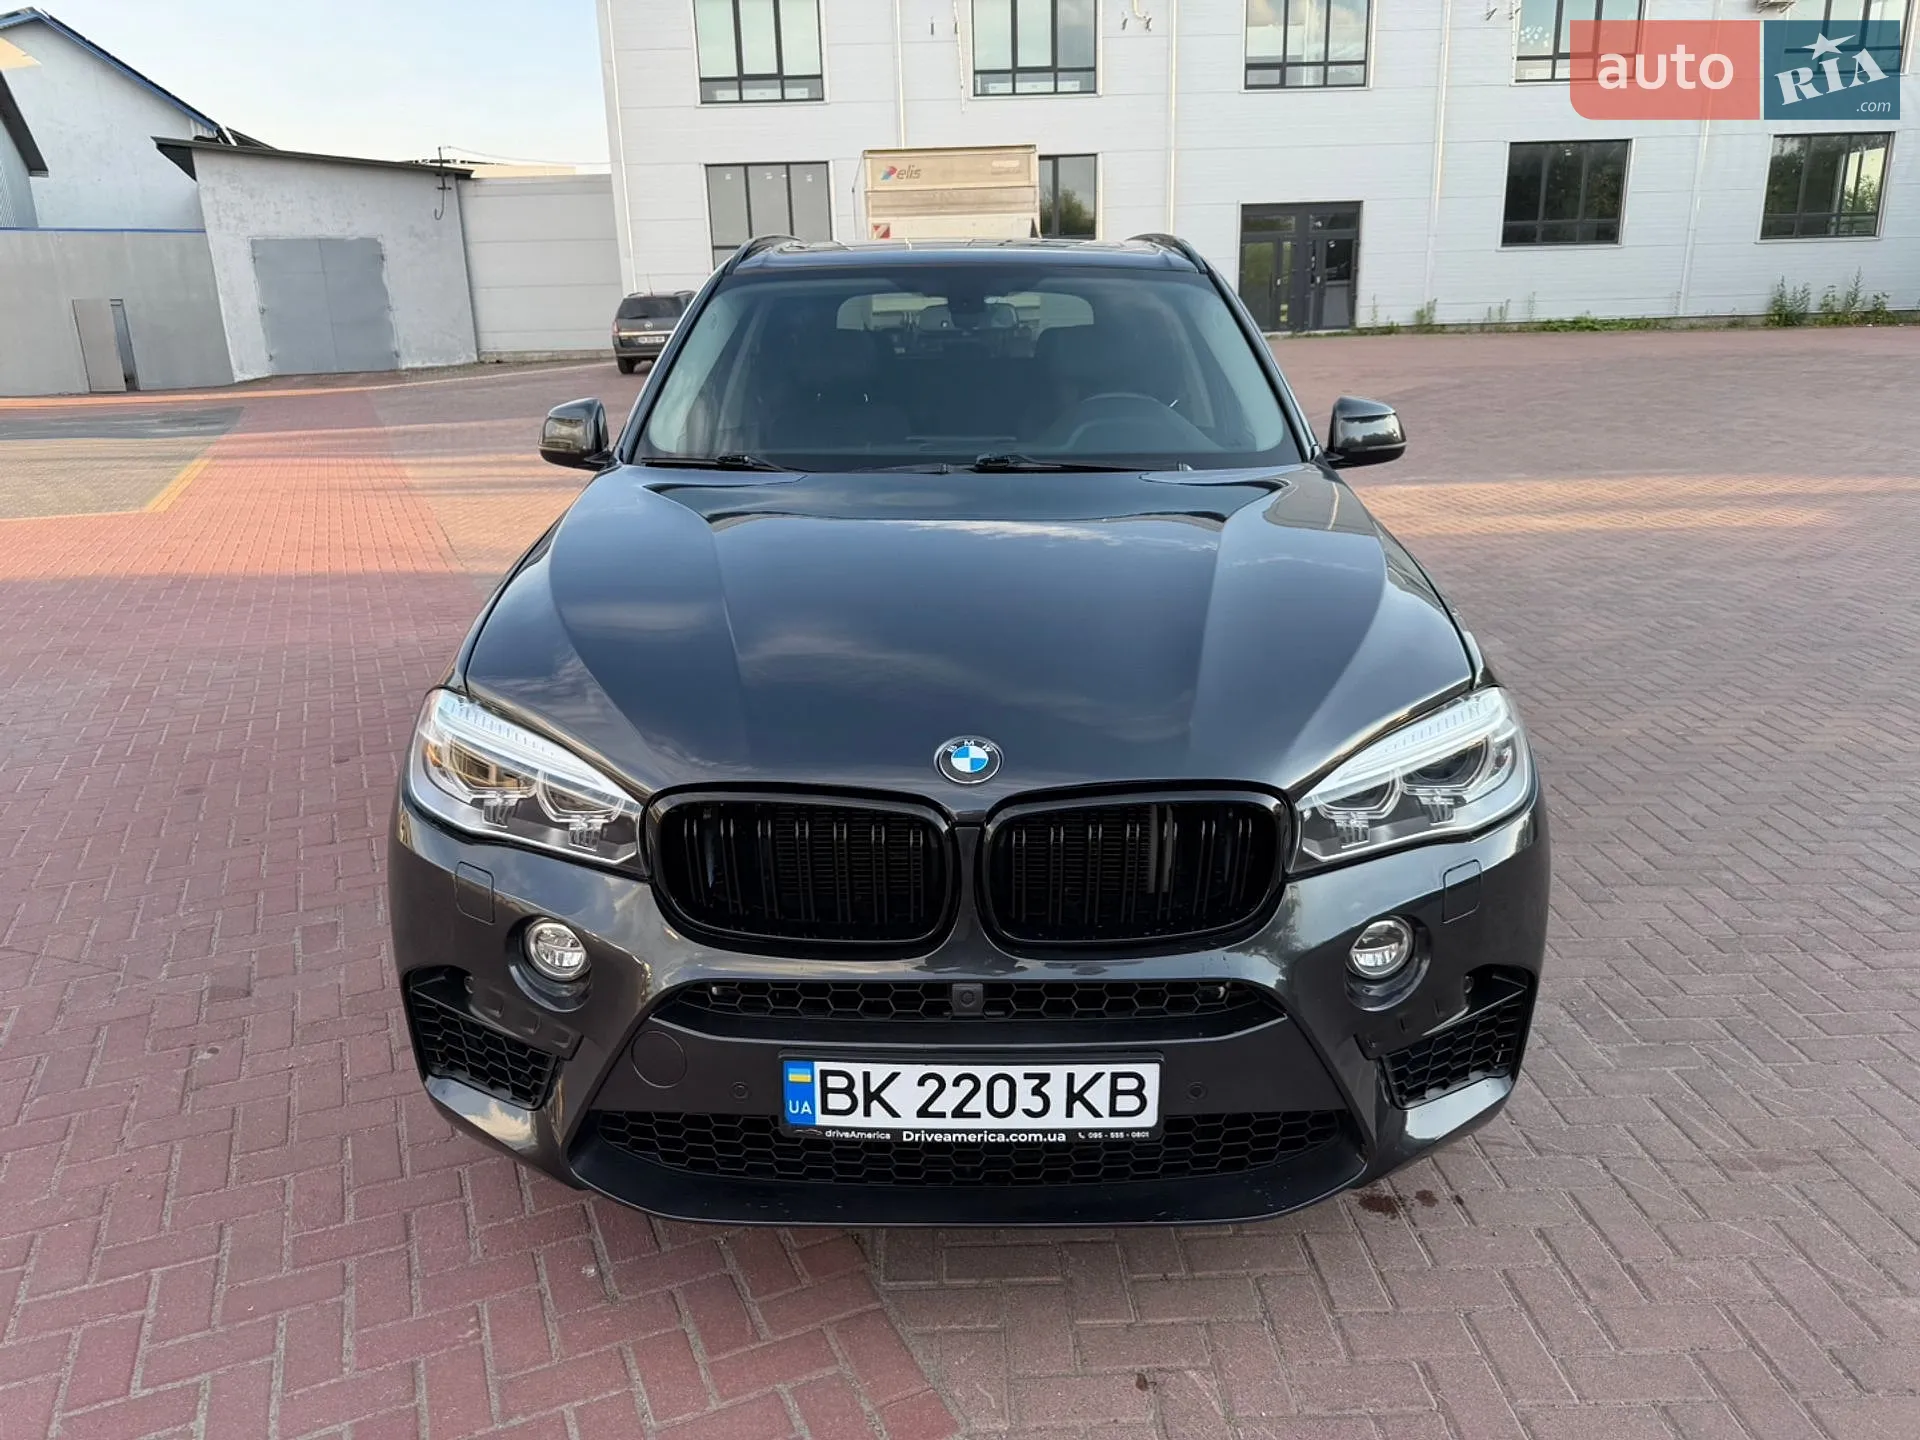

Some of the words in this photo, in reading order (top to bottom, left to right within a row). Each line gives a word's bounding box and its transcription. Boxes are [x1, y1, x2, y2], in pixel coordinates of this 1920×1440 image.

[896, 164, 922, 180] elis
[946, 739, 994, 753] BMW
[819, 1068, 901, 1119] BK
[915, 1071, 1052, 1119] 2203
[1064, 1070, 1149, 1119] KB
[789, 1100, 812, 1115] UA
[825, 1129, 891, 1140] driveAmerica
[902, 1130, 1066, 1143] Driveamerica.com.ua
